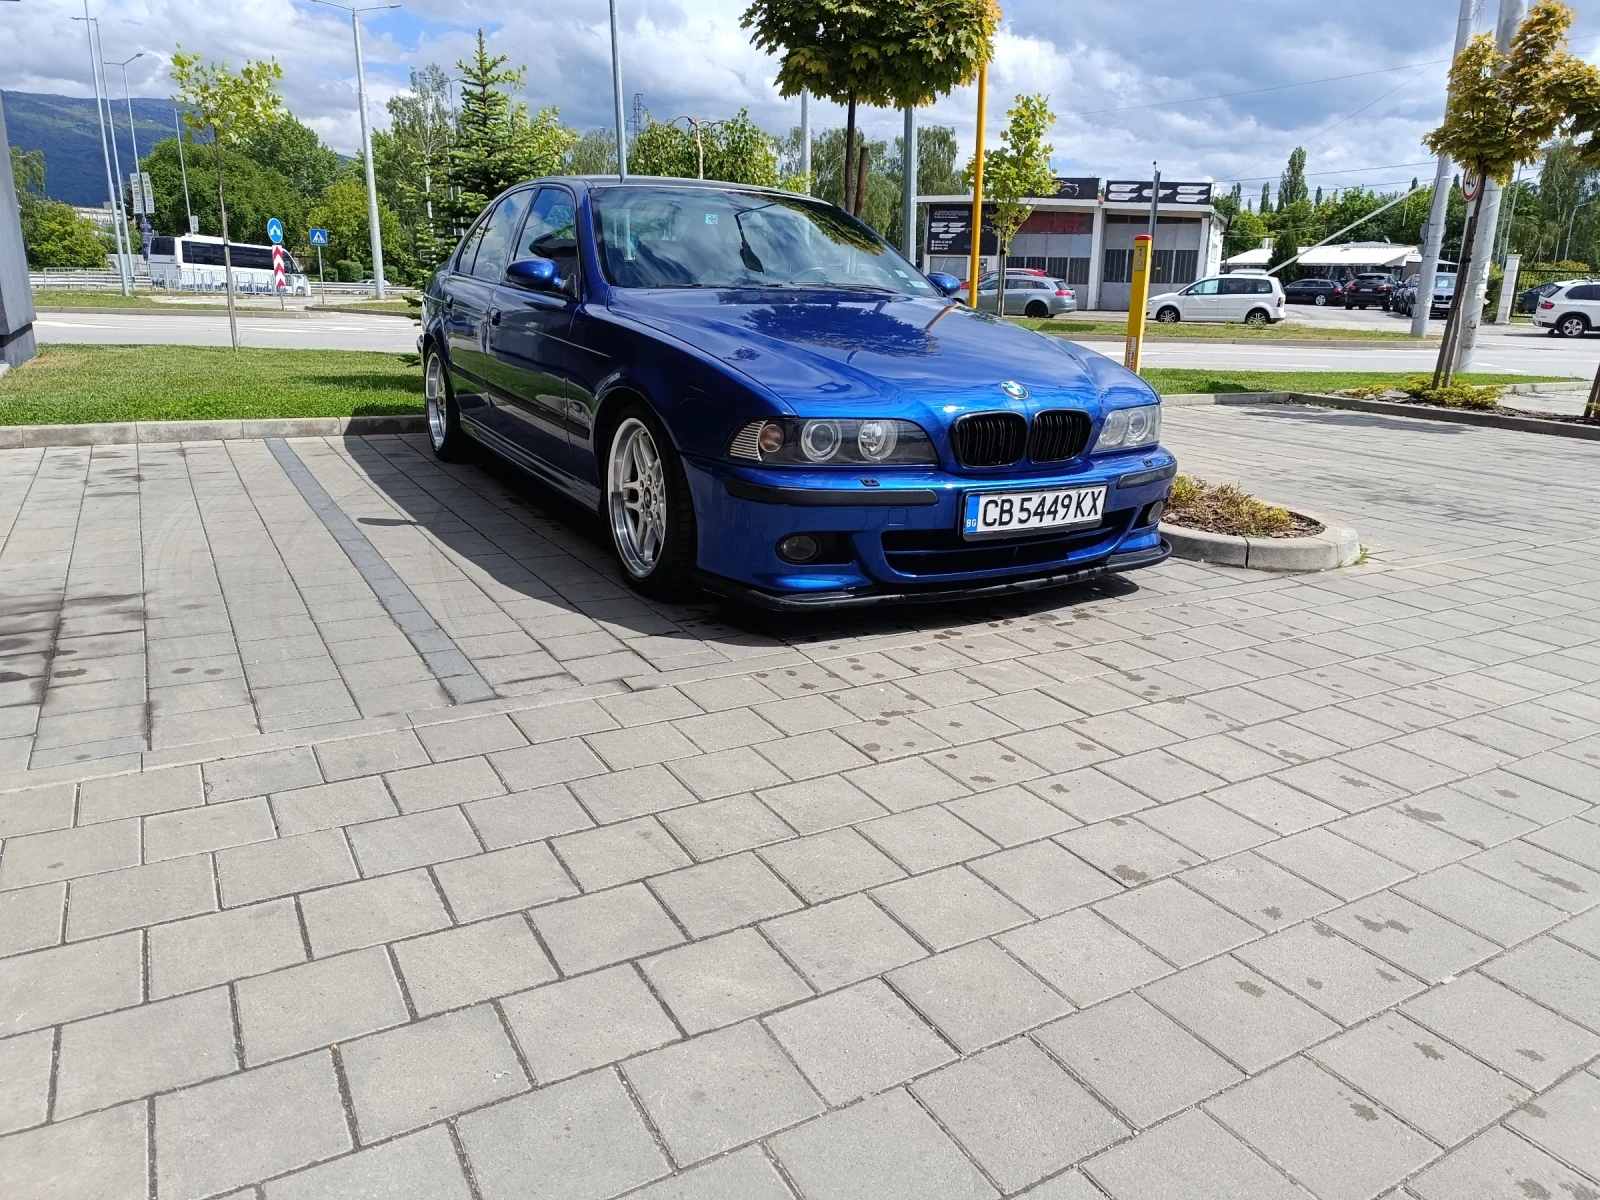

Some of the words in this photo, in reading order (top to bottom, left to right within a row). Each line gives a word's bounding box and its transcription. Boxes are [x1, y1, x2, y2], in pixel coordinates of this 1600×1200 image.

[982, 498, 1014, 527] CB
[1018, 494, 1073, 524] 5449
[1074, 490, 1102, 518] KX
[966, 519, 977, 528] BG
